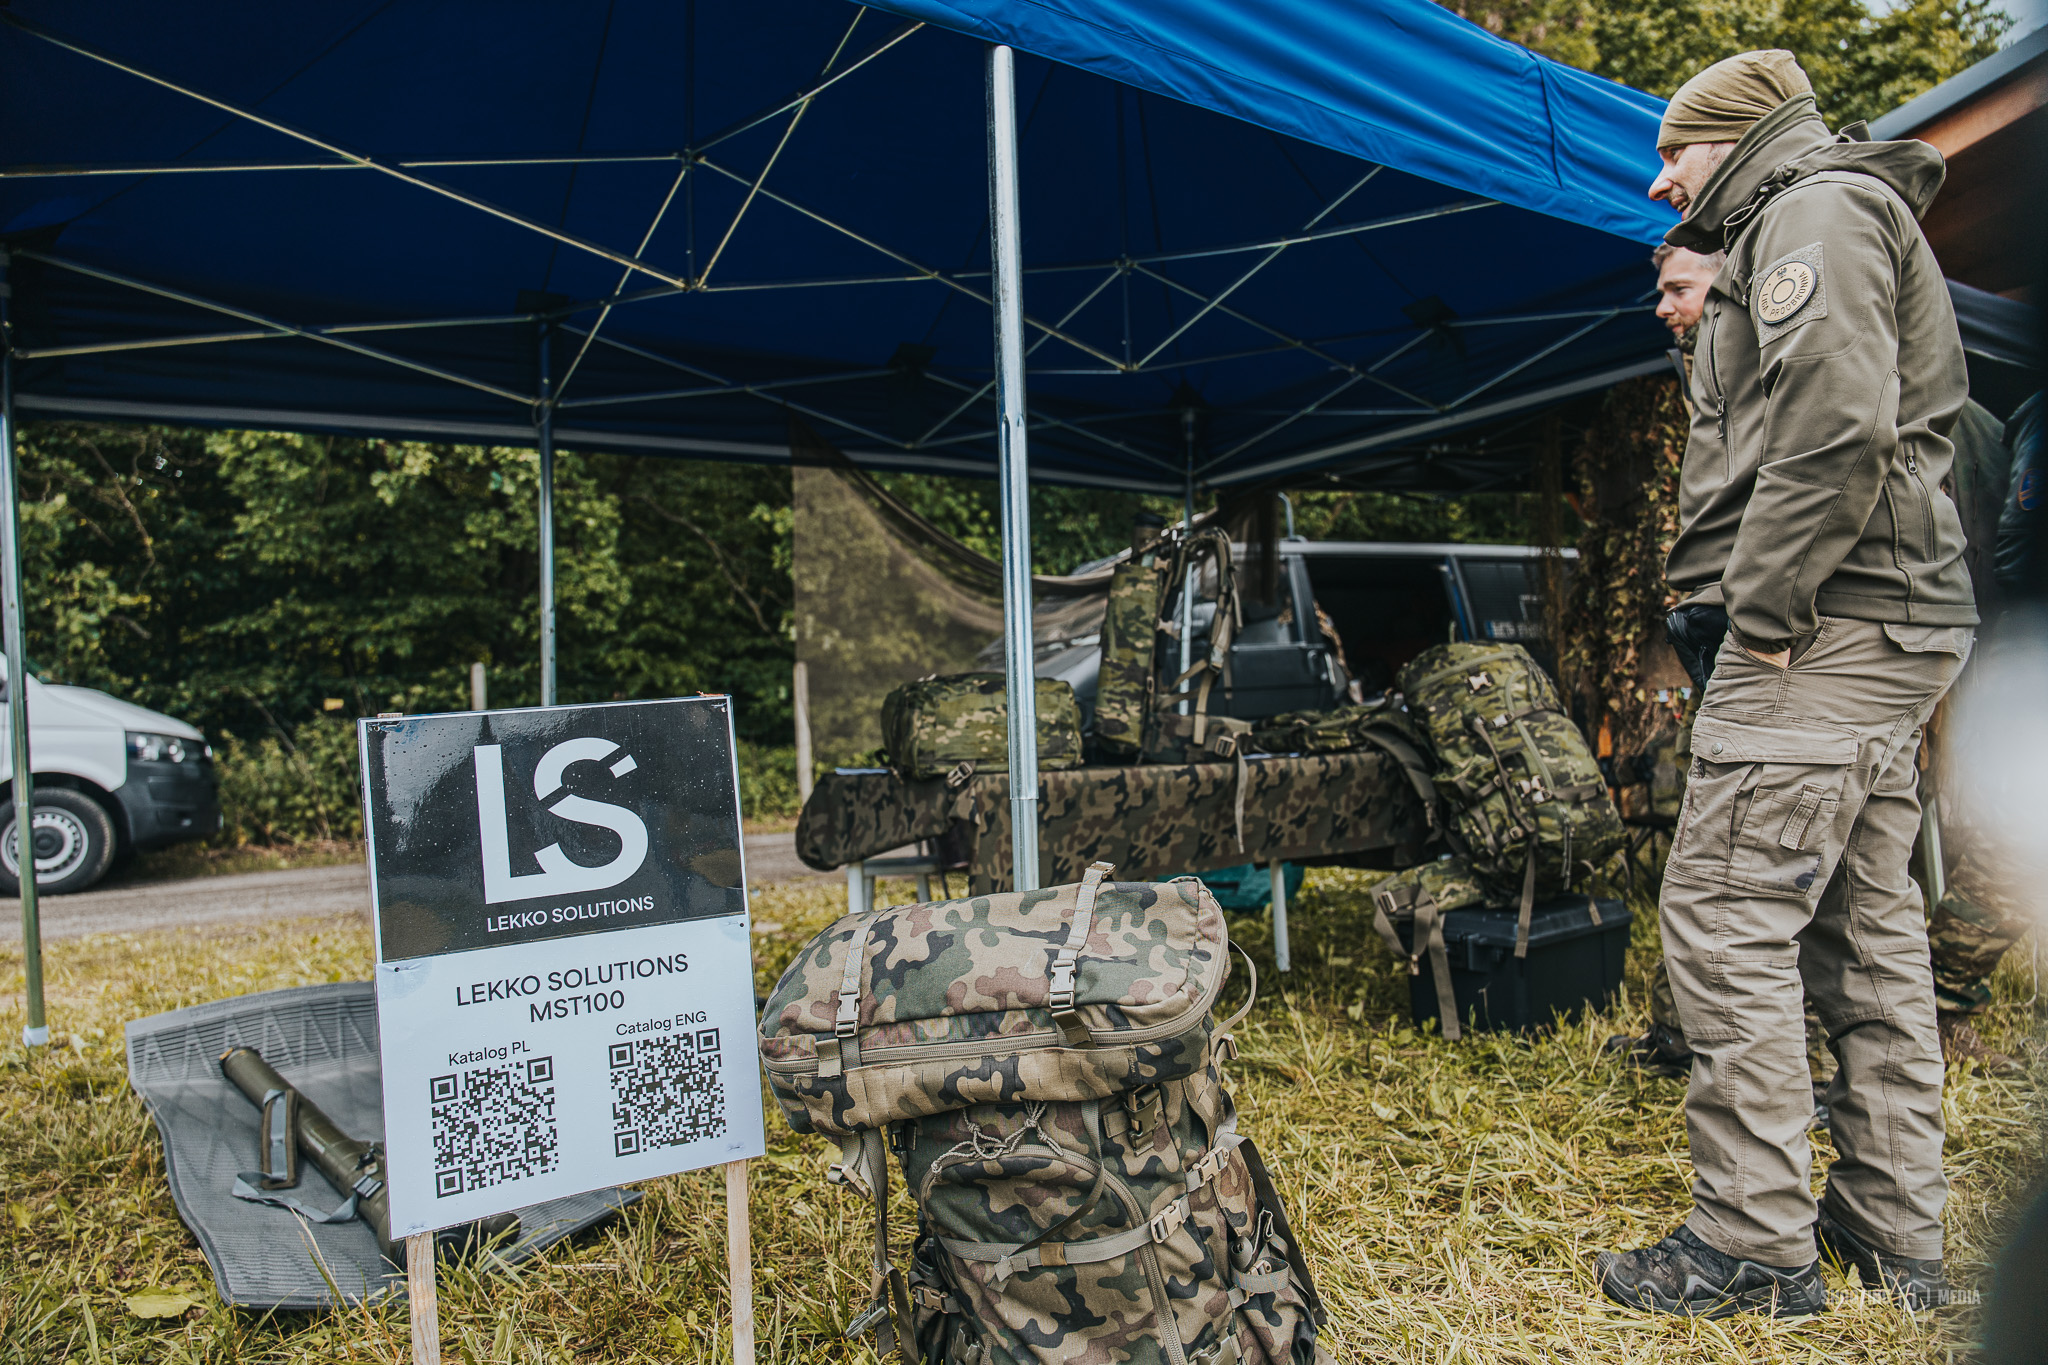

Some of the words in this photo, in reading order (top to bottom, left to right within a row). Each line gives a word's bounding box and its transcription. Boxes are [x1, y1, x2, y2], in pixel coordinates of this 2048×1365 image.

[1770, 271, 1808, 316] PROOBRONNA
[474, 737, 648, 904] LS
[487, 910, 547, 932] LEKKO
[552, 895, 655, 923] SOLUTIONS
[456, 975, 541, 1006] LEKKO
[548, 953, 690, 992] SOLUTIONS
[529, 990, 625, 1023] MST100
[615, 1018, 672, 1036] Catalog
[675, 1010, 707, 1027] ENG
[448, 1045, 508, 1067] Katalog
[511, 1040, 531, 1055] PL
